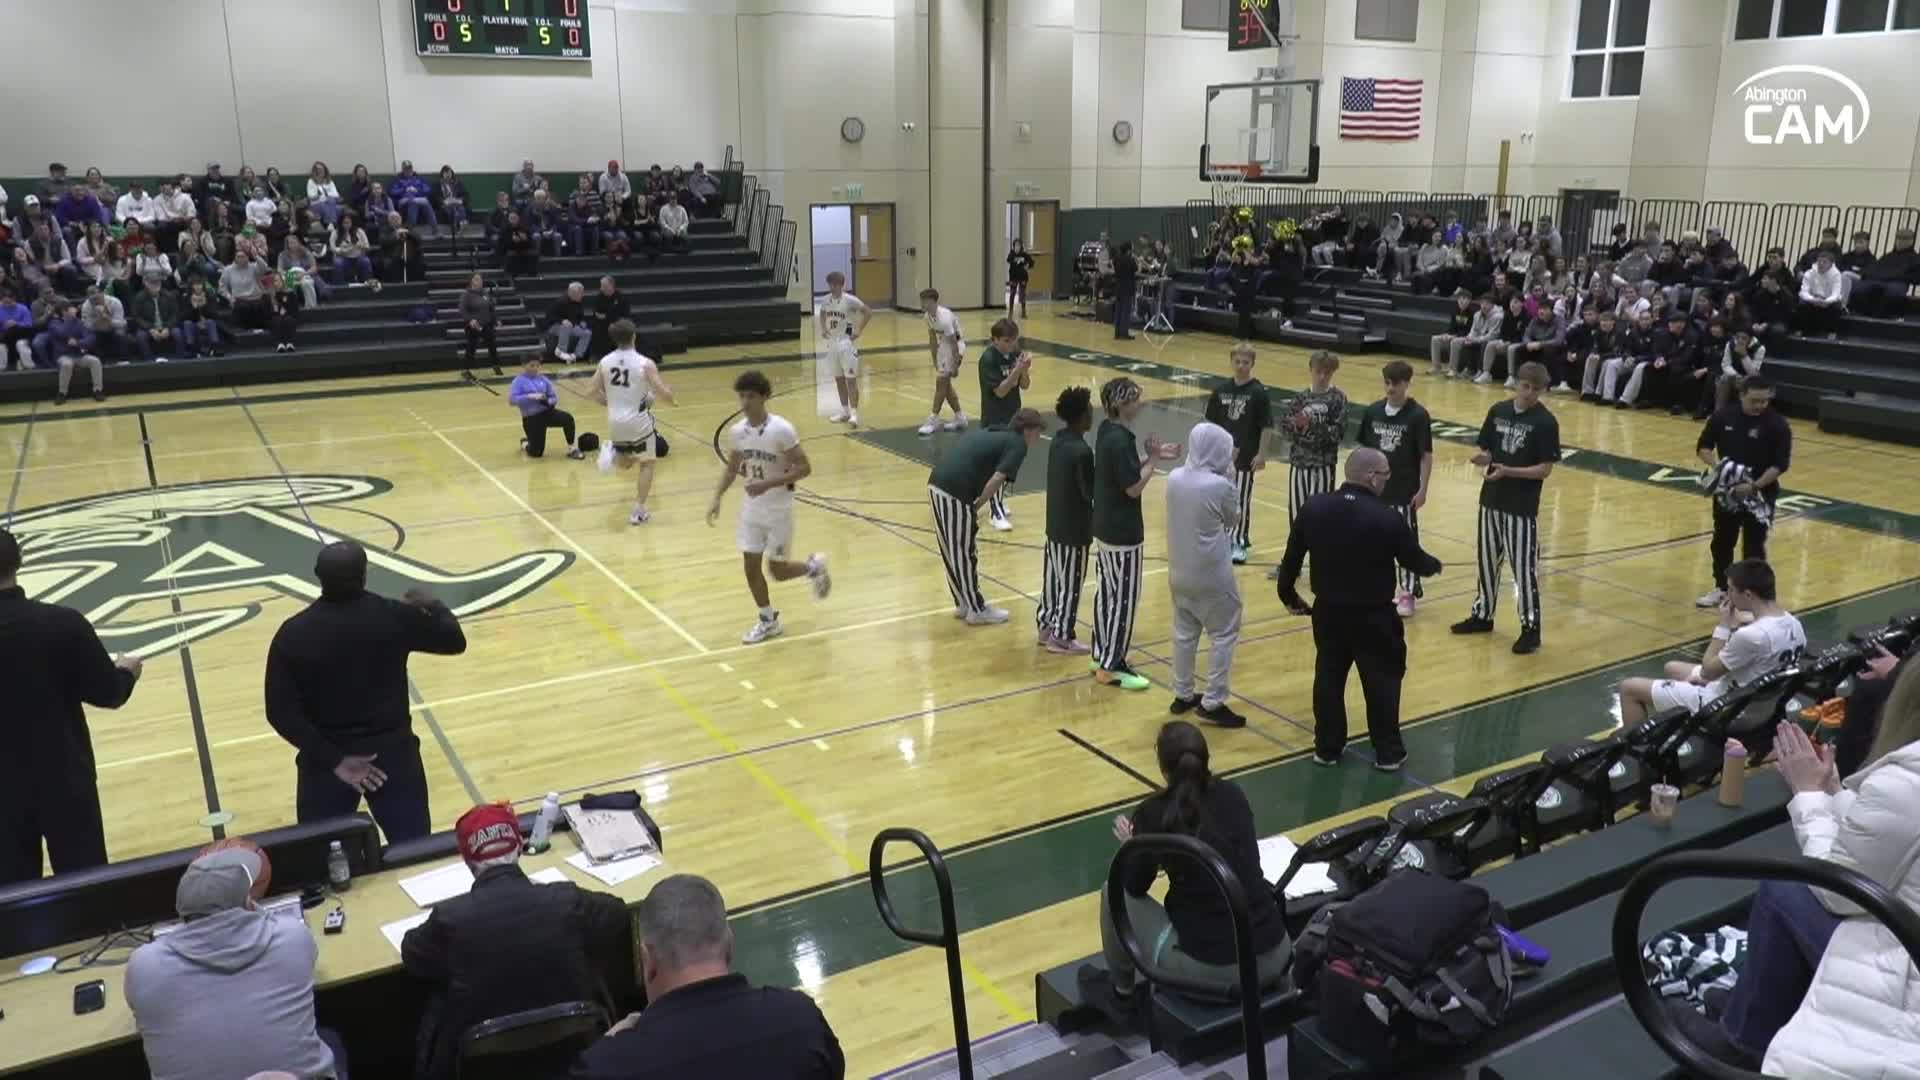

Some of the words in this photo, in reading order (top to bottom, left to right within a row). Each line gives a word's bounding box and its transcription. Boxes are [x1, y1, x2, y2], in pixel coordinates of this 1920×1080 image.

[424, 13, 447, 22] FOULS
[482, 16, 509, 25] PLAYER
[511, 17, 528, 25] FOUL
[560, 19, 582, 28] FOULS
[433, 22, 445, 41] 0
[460, 23, 472, 42] 5
[539, 27, 550, 45] 5
[569, 28, 579, 46] 0
[494, 46, 519, 54] MATCH
[562, 48, 583, 56] SCORE
[610, 367, 630, 388] 21
